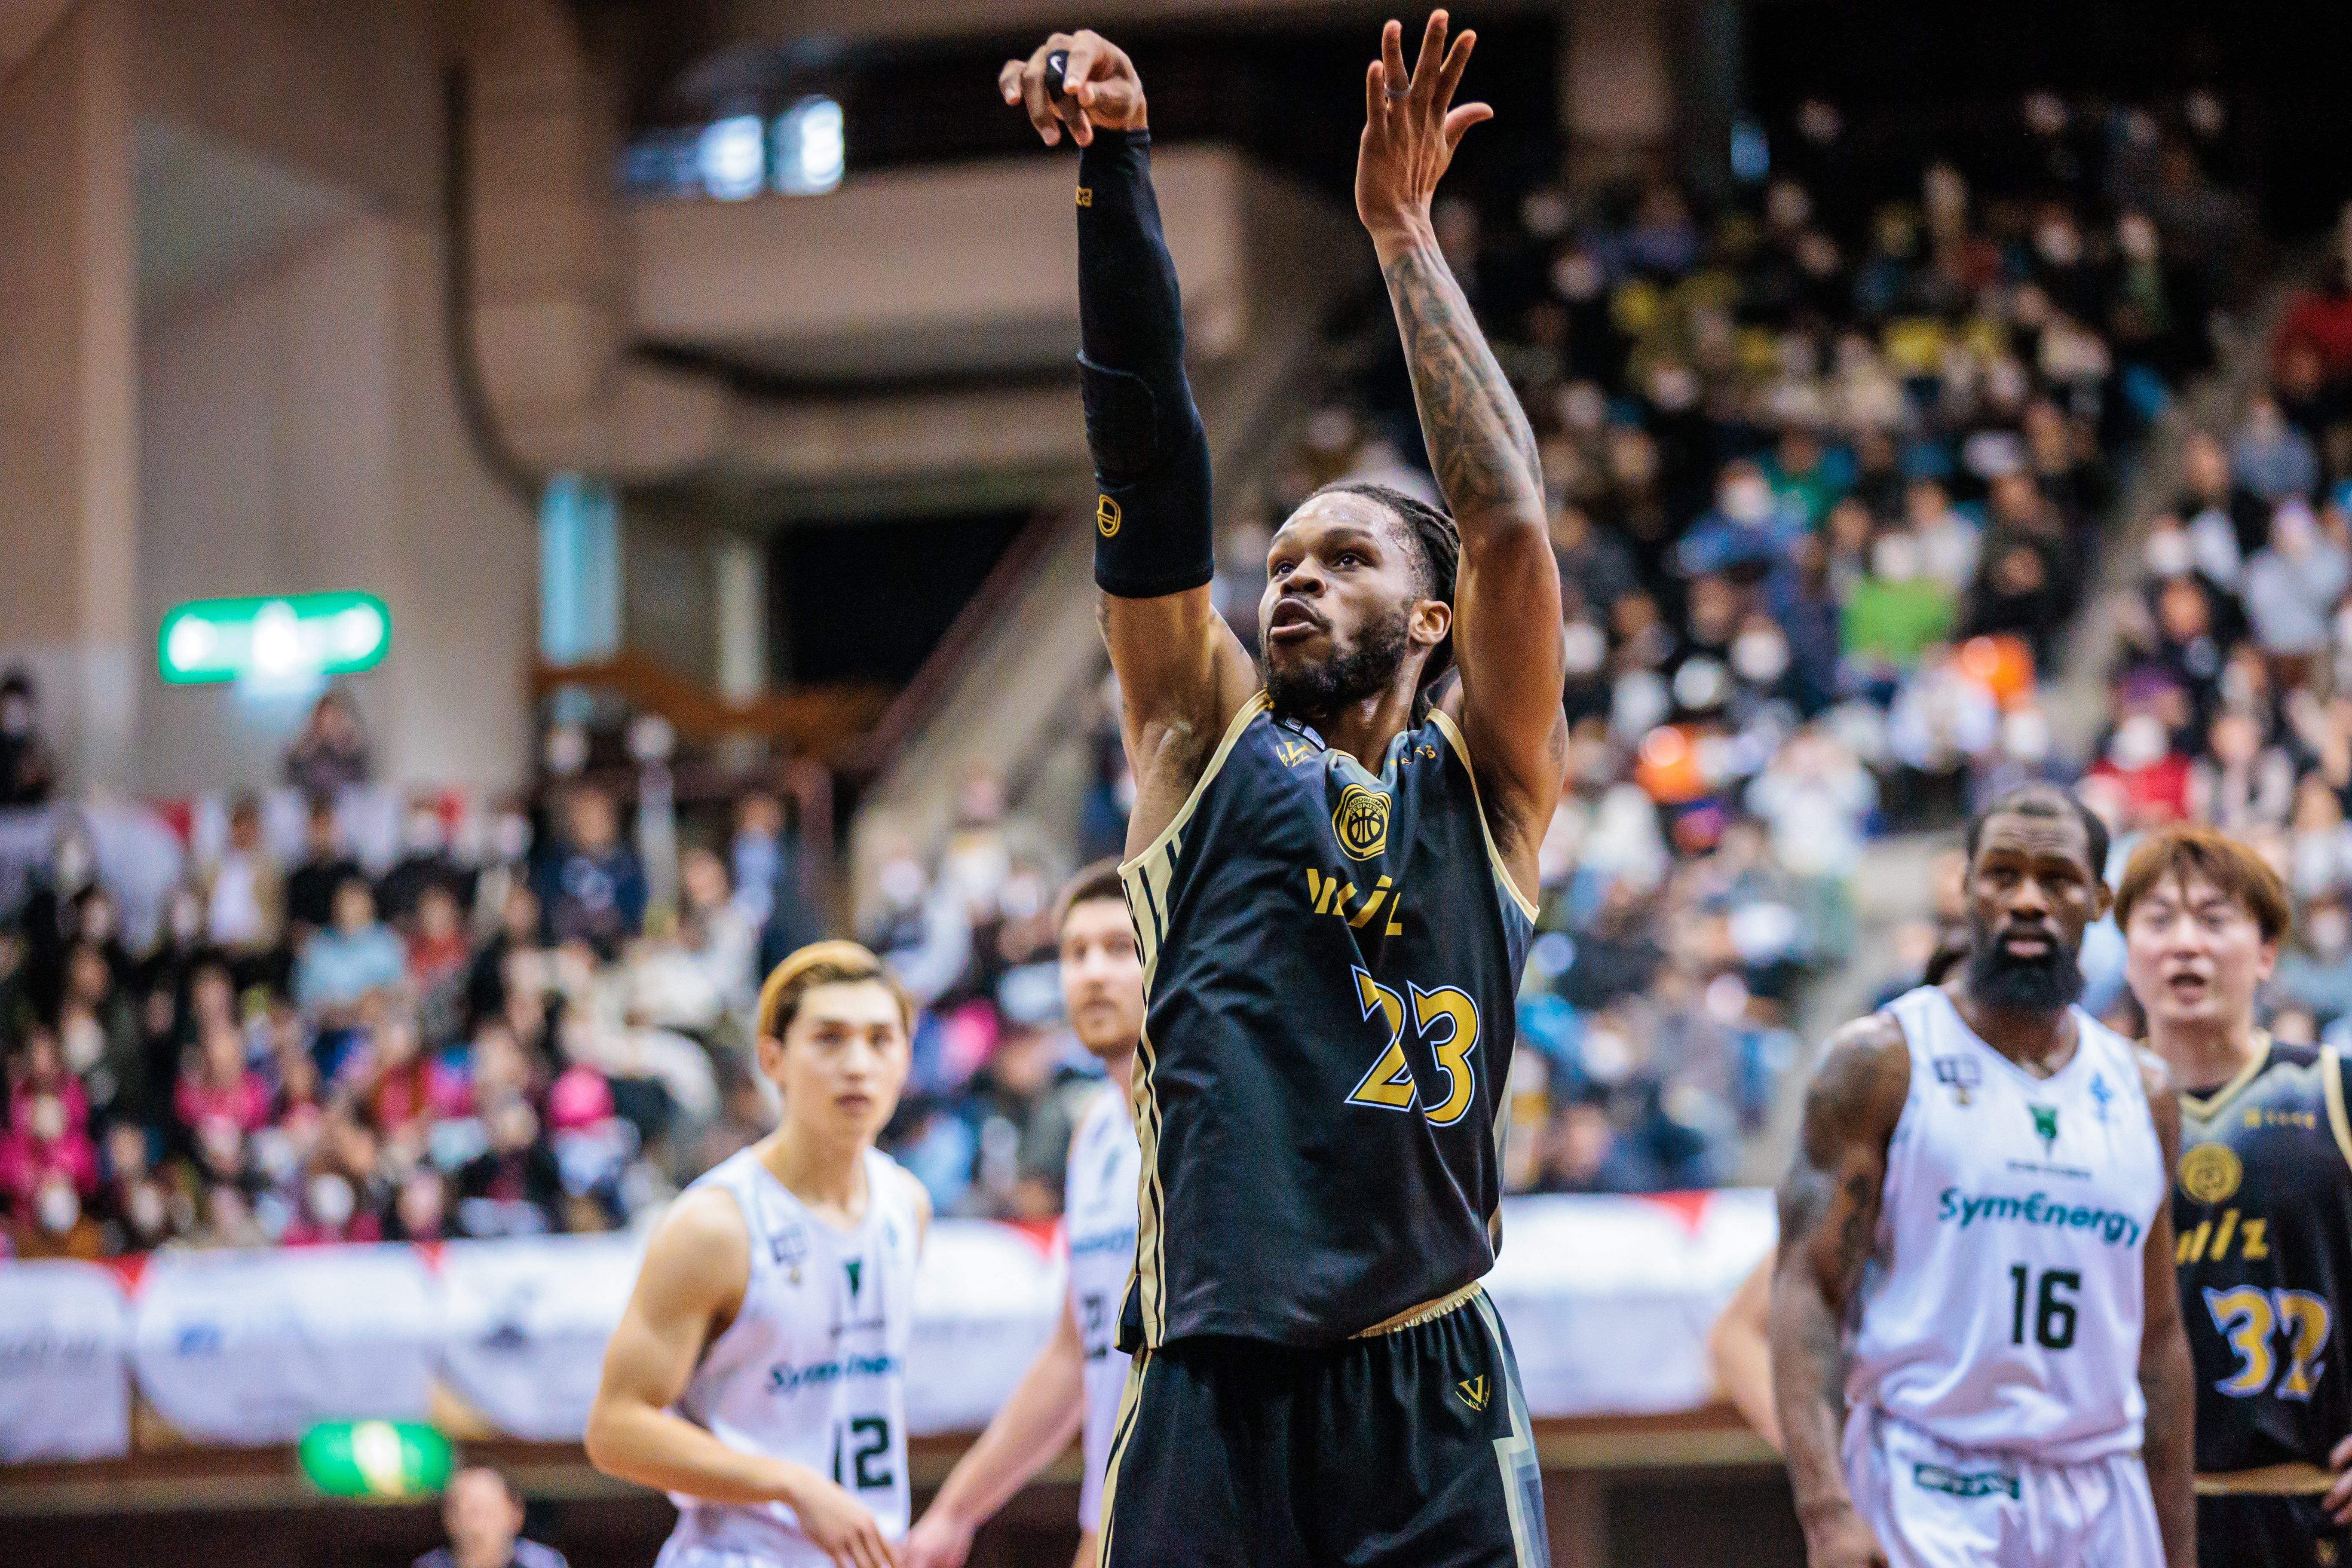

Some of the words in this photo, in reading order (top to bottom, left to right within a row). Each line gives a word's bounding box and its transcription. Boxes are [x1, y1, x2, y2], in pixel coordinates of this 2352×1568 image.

[1348, 797, 1384, 811] KAGOSHIMA
[1344, 964, 1480, 1127] 23
[1938, 1188, 2140, 1248] SymEnergy
[2010, 1264, 2081, 1350] 16
